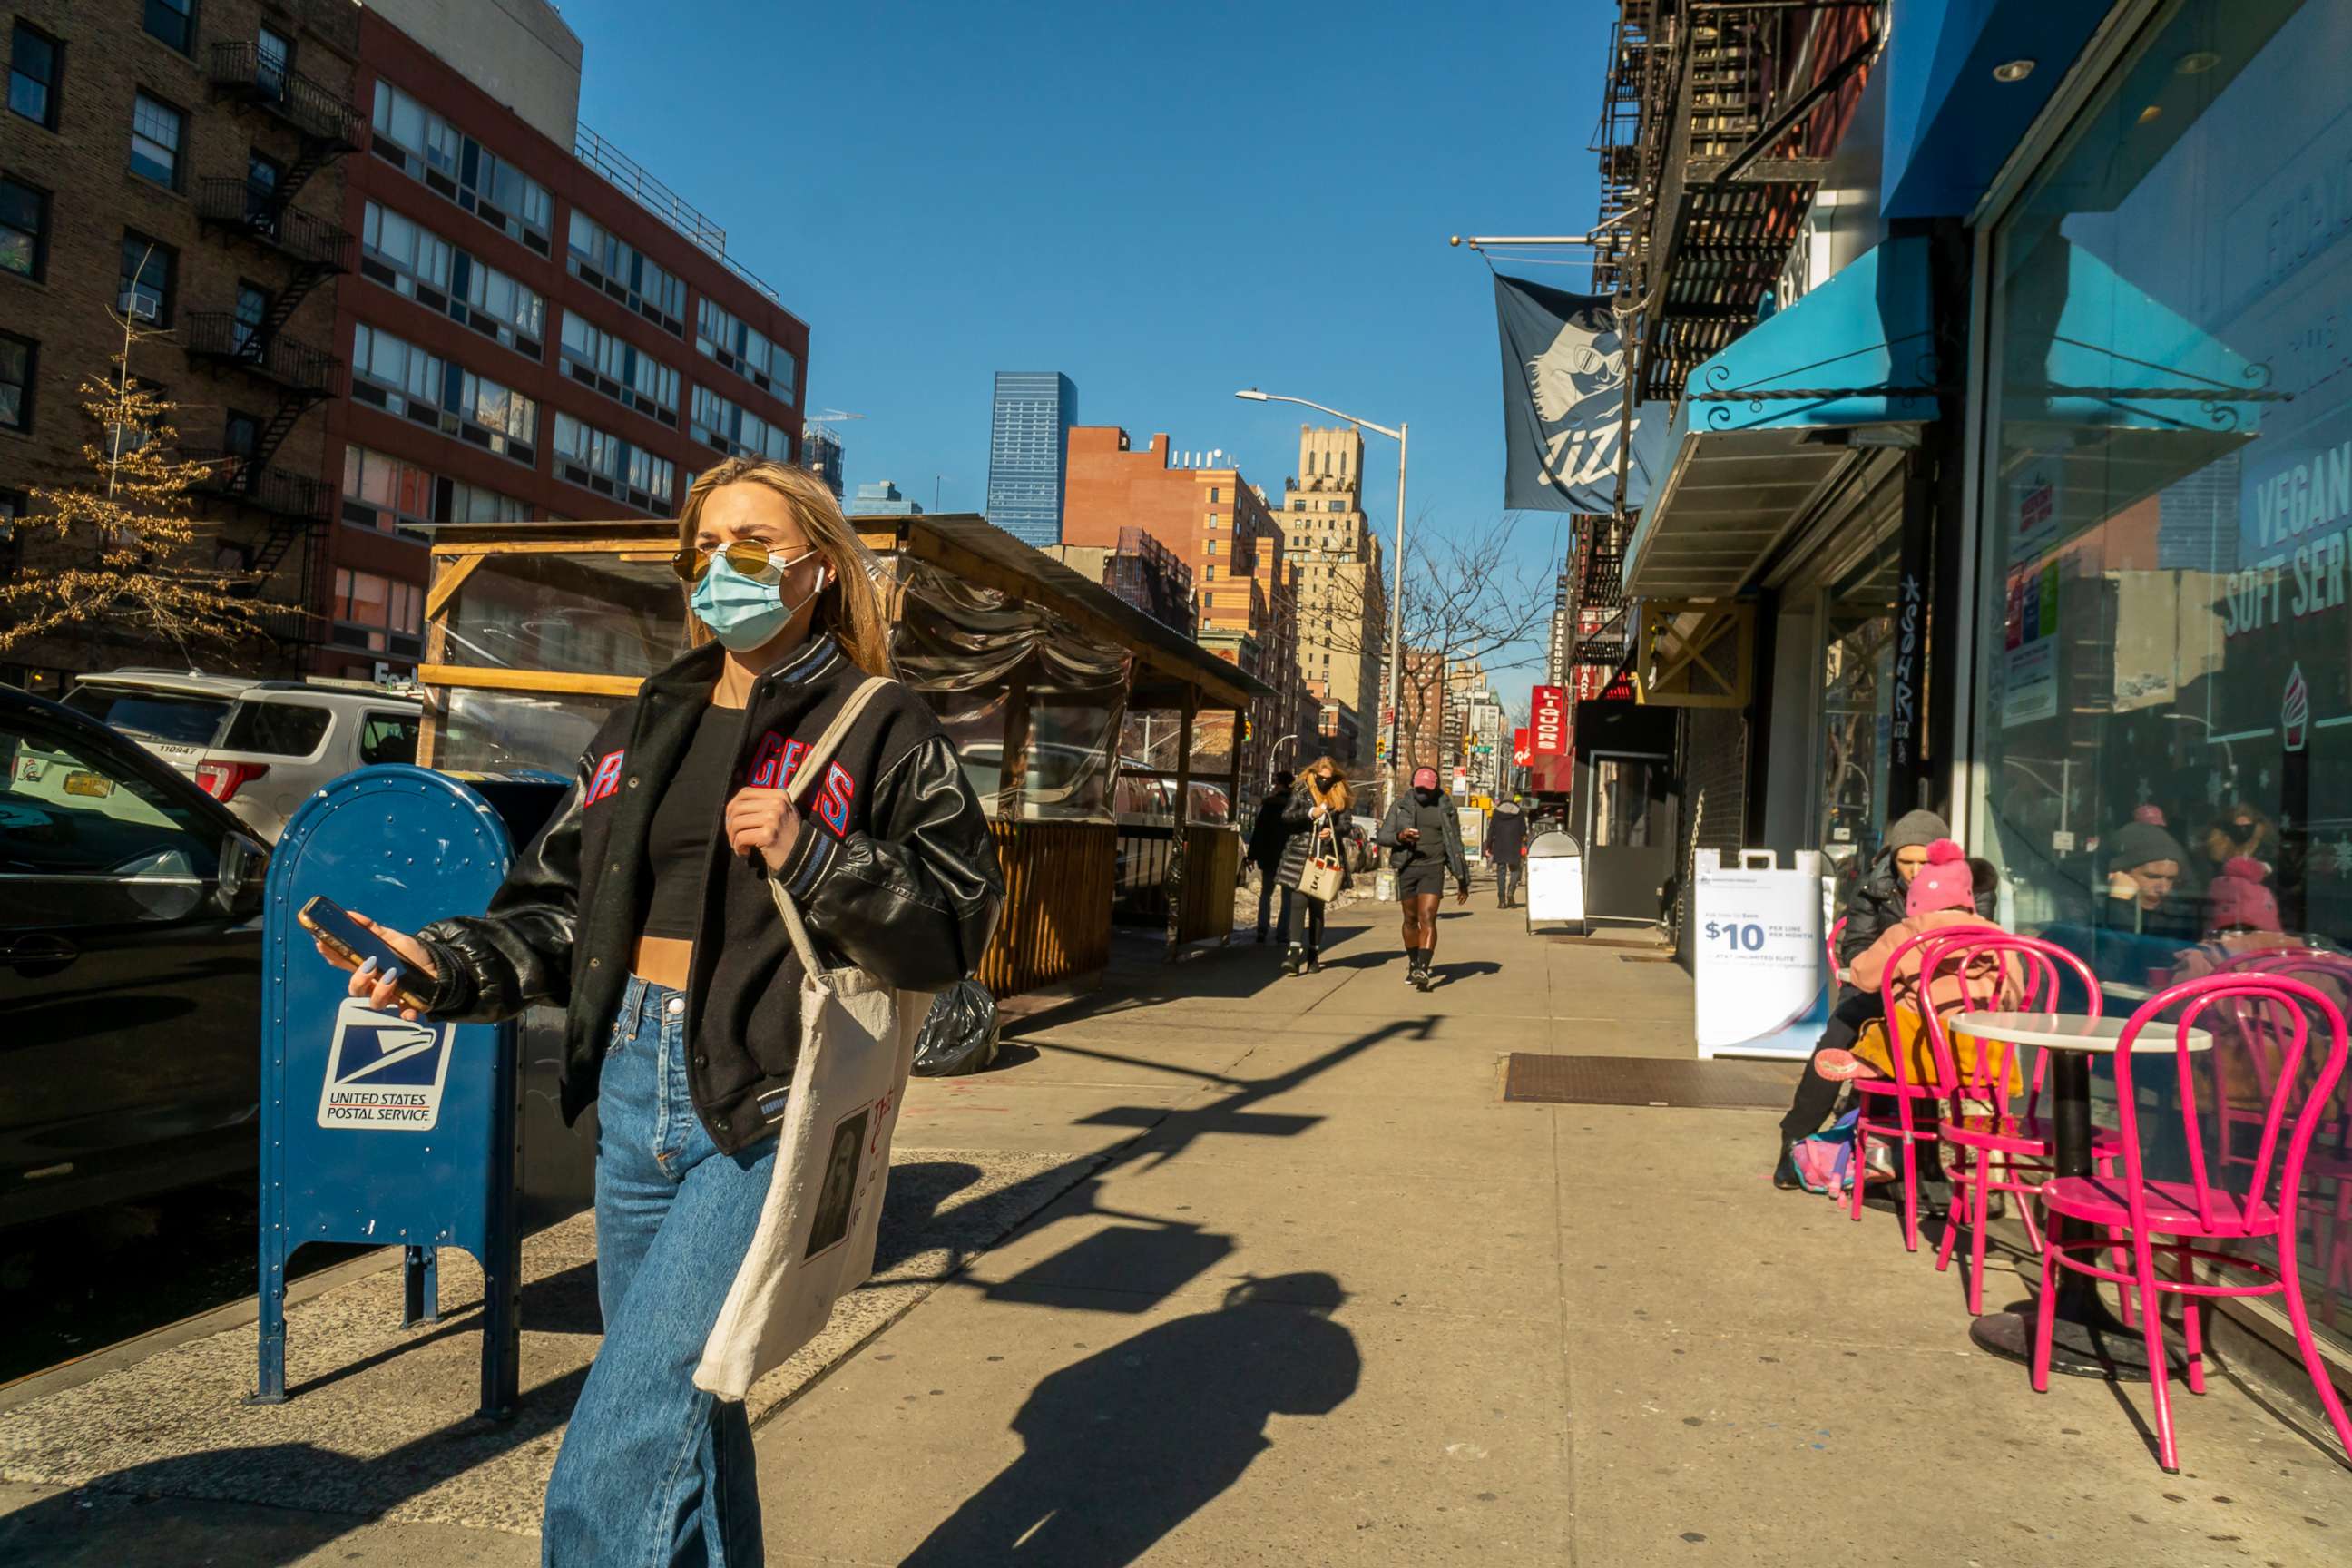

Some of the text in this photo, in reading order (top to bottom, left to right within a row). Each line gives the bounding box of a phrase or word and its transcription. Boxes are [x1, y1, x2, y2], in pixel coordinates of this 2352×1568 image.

[2257, 441, 2352, 548] VEGAN
[2225, 526, 2352, 637] SOFT SER
[1537, 691, 1560, 750] LIQUORS
[159, 744, 197, 755] 110947
[748, 730, 855, 838] GES
[1705, 920, 1764, 951] $10
[327, 1107, 429, 1122] POSTAL SERVICE
[330, 1092, 426, 1105] UNITED STATES
